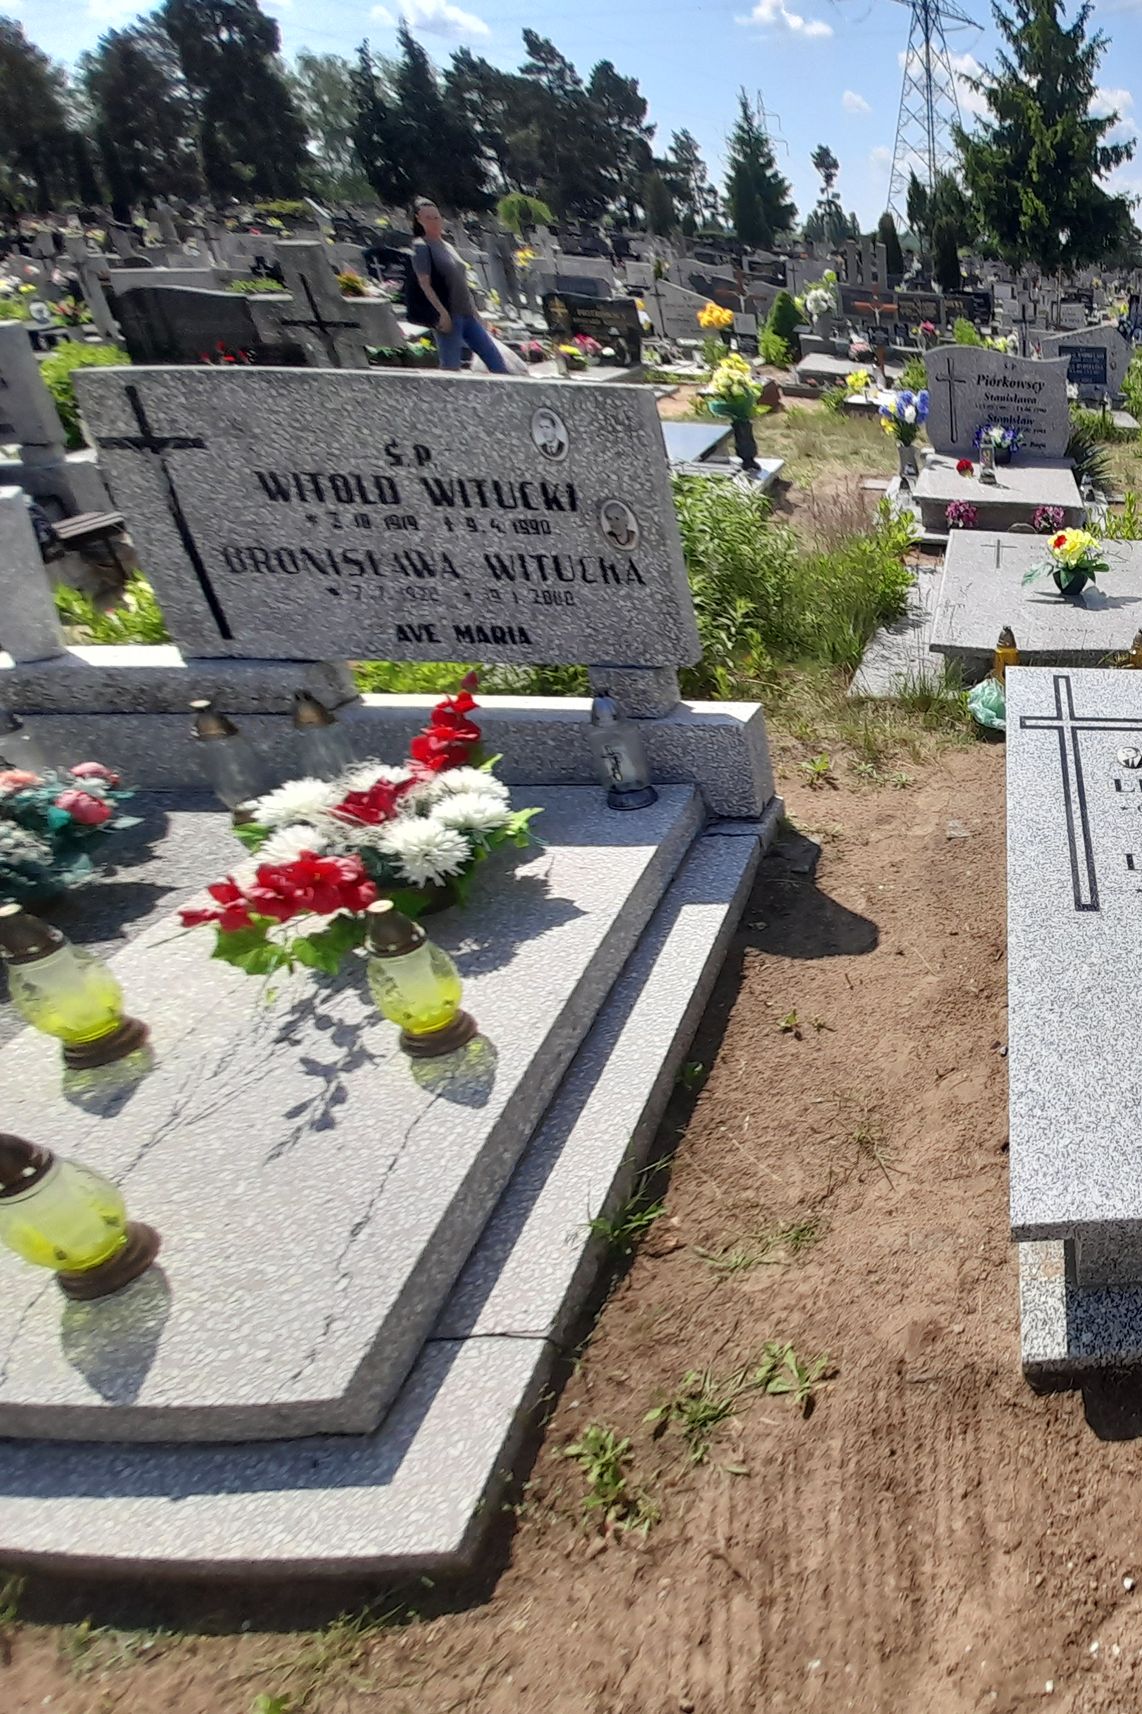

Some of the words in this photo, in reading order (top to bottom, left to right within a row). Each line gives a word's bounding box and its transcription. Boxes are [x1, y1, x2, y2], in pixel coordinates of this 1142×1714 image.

[976, 374, 1045, 393] Piórkowscy
[254, 470, 401, 505] WITOLD
[420, 476, 578, 512] WITUCKI
[397, 622, 442, 644] AVE
[453, 624, 533, 646] MARIA
